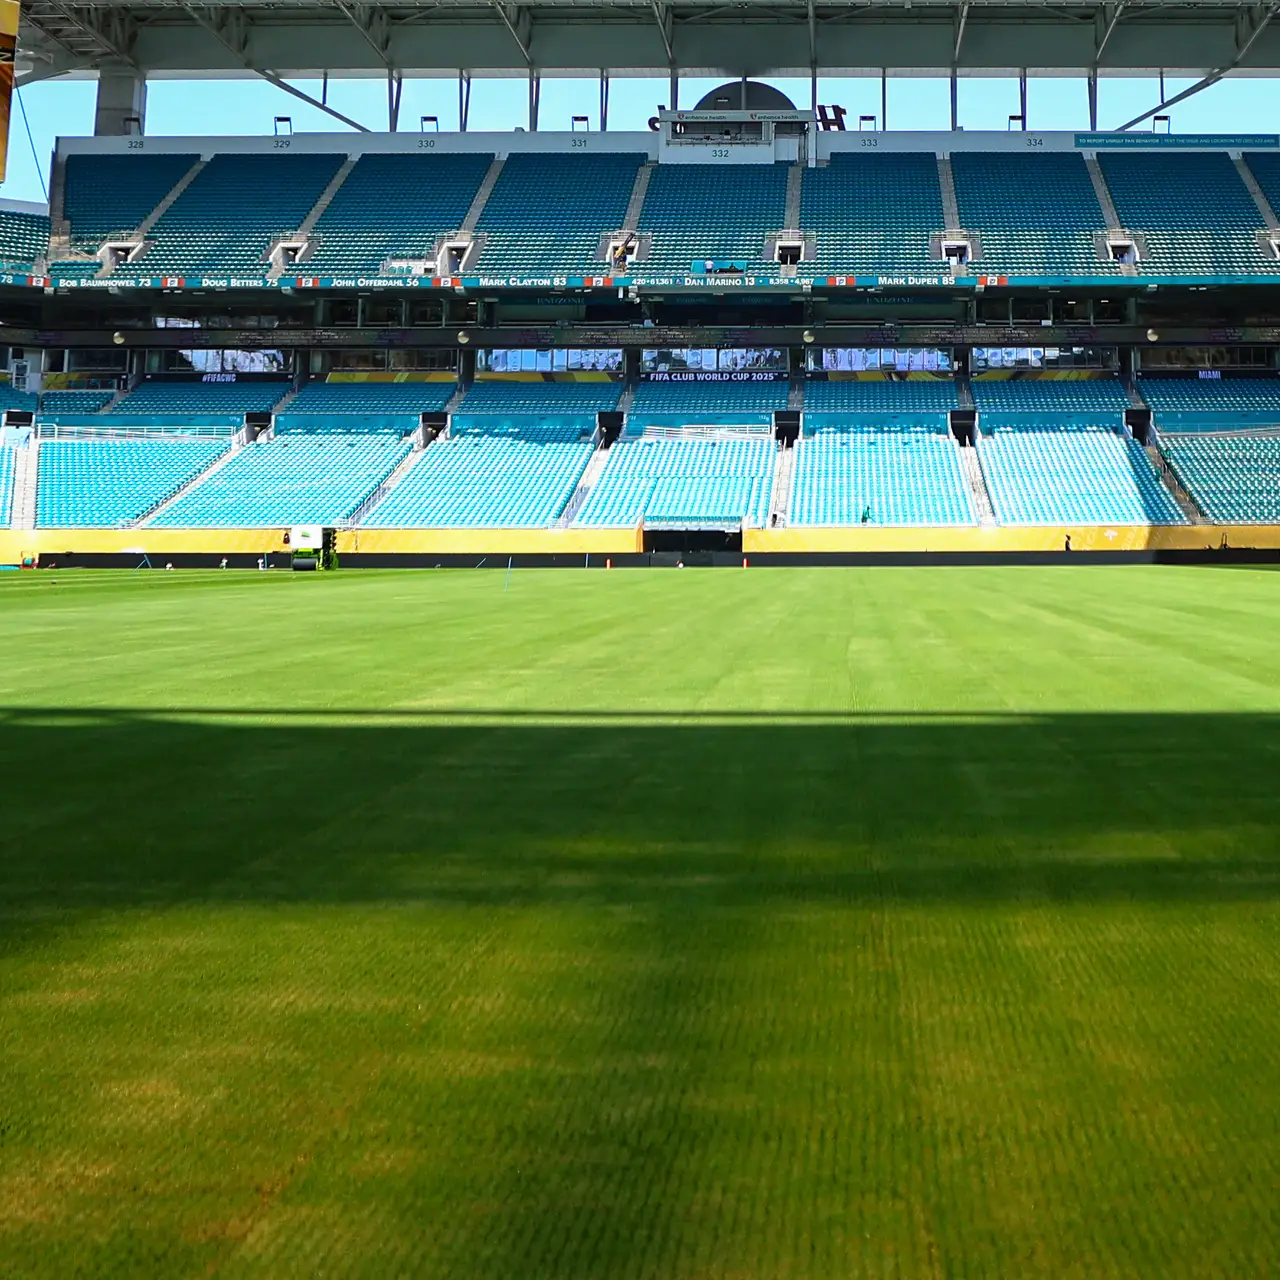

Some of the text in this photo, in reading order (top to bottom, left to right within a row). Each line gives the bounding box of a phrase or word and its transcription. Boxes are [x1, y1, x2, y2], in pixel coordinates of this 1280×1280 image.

[127, 140, 144, 149] 328
[273, 140, 290, 149] 329
[418, 140, 435, 148] 330
[572, 139, 587, 148] 331
[861, 138, 878, 147] 333
[1027, 138, 1043, 147] 334
[712, 149, 729, 158] 332
[0, 274, 14, 284] 78
[58, 278, 152, 288] BOB BAUMHOWER 73
[202, 278, 279, 287] DOUG BETTERS 75
[479, 277, 567, 286] MARK CLAYTON 83
[684, 278, 704, 286] DAN
[706, 278, 742, 286] MARINO
[744, 277, 755, 286] 13
[877, 276, 955, 285] MARK DUPER 85
[330, 280, 356, 288] JOHN
[357, 280, 404, 288] OFFERDAHL
[202, 373, 237, 383] #FIFACWC
[650, 373, 670, 381] FIFA
[671, 373, 695, 381] CLUB
[696, 373, 730, 381] WORLD
[731, 373, 750, 381] CUP
[1198, 370, 1221, 380] MIAMI
